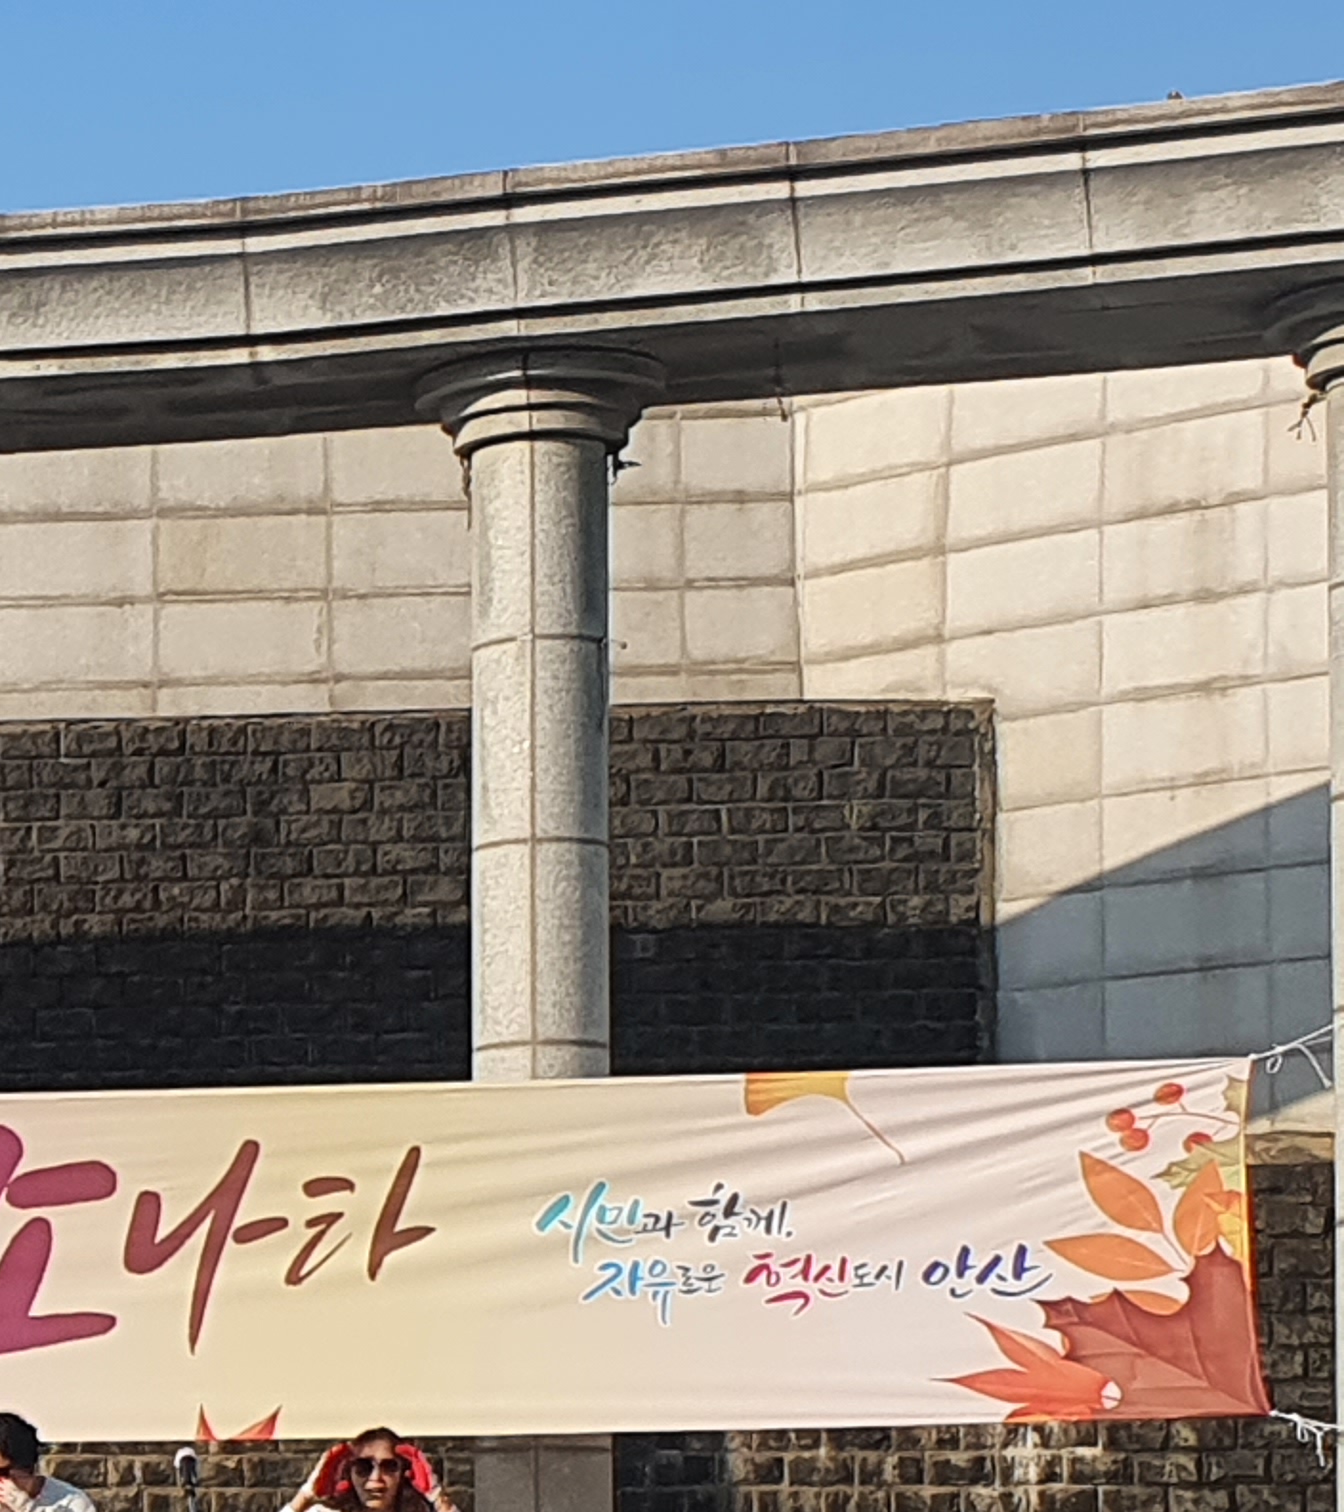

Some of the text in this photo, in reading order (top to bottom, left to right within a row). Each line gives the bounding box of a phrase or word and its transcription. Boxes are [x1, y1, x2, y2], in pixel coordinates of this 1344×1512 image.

[536, 1182, 683, 1264] 시민과
[582, 1244, 1052, 1323] 자유로운 혁신도시 안산
